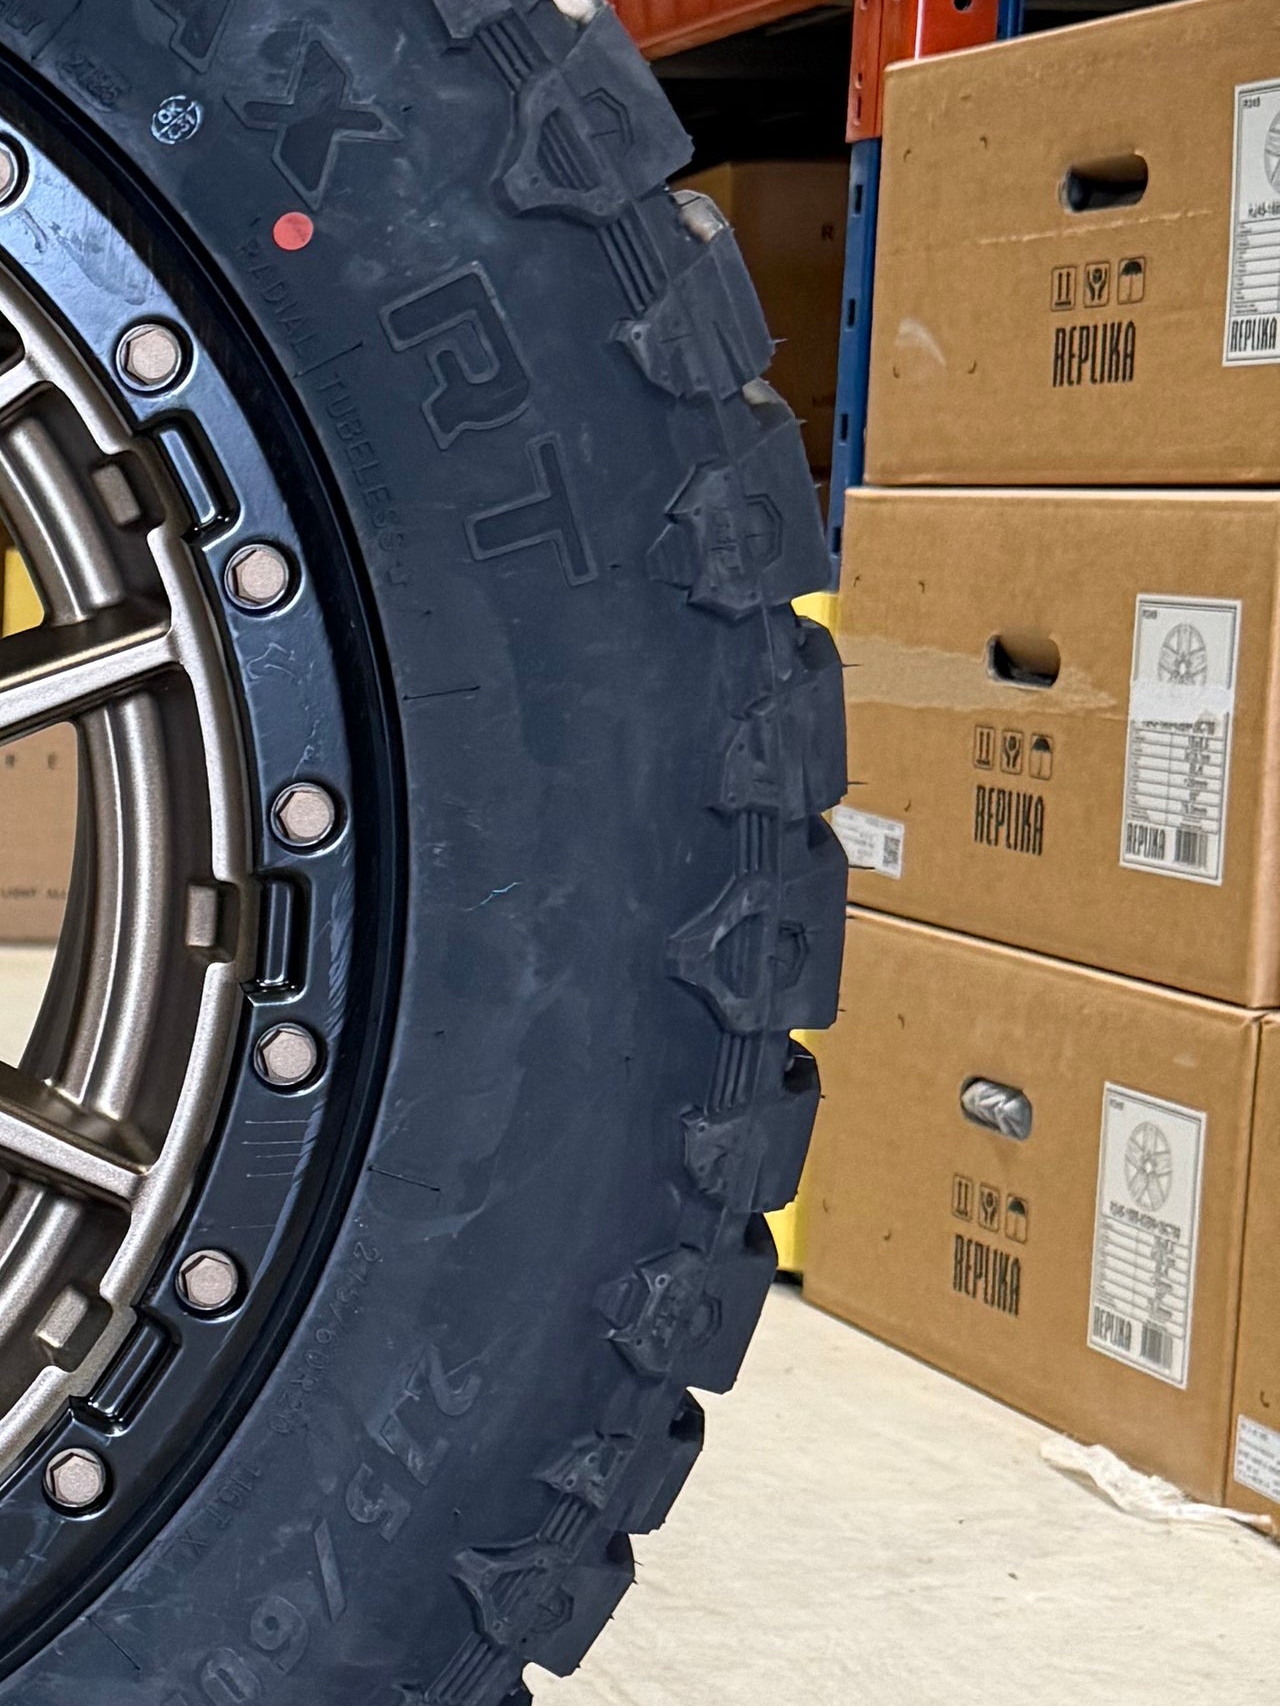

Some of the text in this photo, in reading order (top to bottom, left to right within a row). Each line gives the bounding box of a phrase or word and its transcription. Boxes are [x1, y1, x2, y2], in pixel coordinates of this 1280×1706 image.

[1052, 320, 1136, 389] REPLIKA
[1229, 315, 1278, 354] REPLIKA
[237, 236, 407, 554] RADIAL TUBELESS
[379, 260, 601, 586] RT
[973, 783, 1046, 857] REPLIKA
[1124, 822, 1167, 861] REPLIKA
[952, 1232, 1022, 1318] REPLIKA
[1092, 1304, 1133, 1353] REPLIKA
